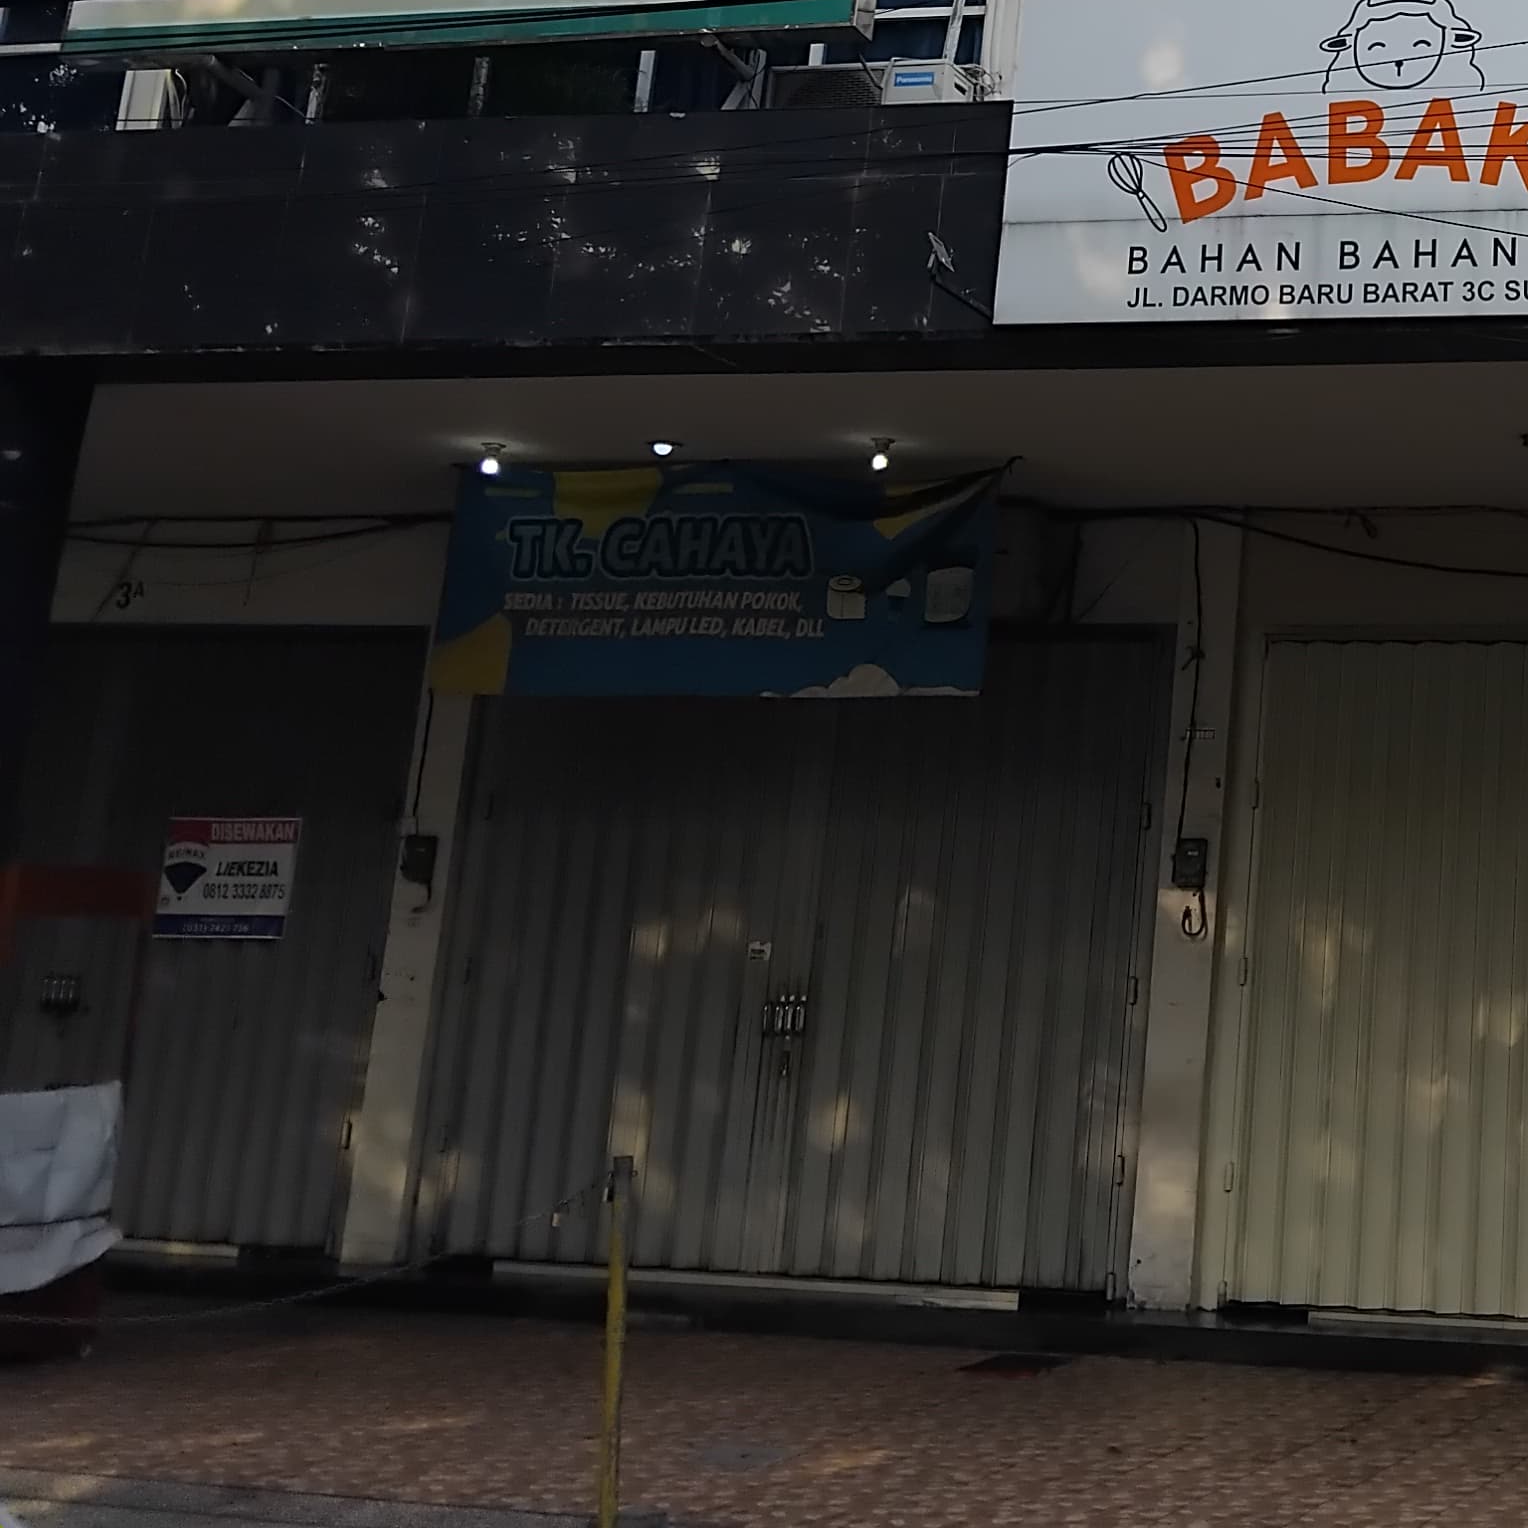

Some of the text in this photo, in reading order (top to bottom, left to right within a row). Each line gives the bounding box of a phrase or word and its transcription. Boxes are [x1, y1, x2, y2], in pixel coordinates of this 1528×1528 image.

[1127, 241, 1301, 275] BAHAN
[1339, 236, 1517, 271] BAHAN
[1127, 286, 1164, 308] JL.
[1172, 284, 1270, 308] DARMO
[1279, 283, 1353, 305] BARU
[1362, 280, 1454, 304] BARAT
[1461, 279, 1496, 303] 3C
[509, 515, 813, 579] TK. CAHAYA
[503, 592, 553, 610] SEDIA
[569, 592, 630, 612] TISSUE,
[634, 591, 740, 610] KEBUTUHAN
[741, 591, 802, 612] POKOK,
[525, 617, 626, 639] DETERGENT,
[630, 616, 688, 637] LAMPU
[796, 617, 825, 639] DLL
[211, 822, 296, 841] DISEWAKAN
